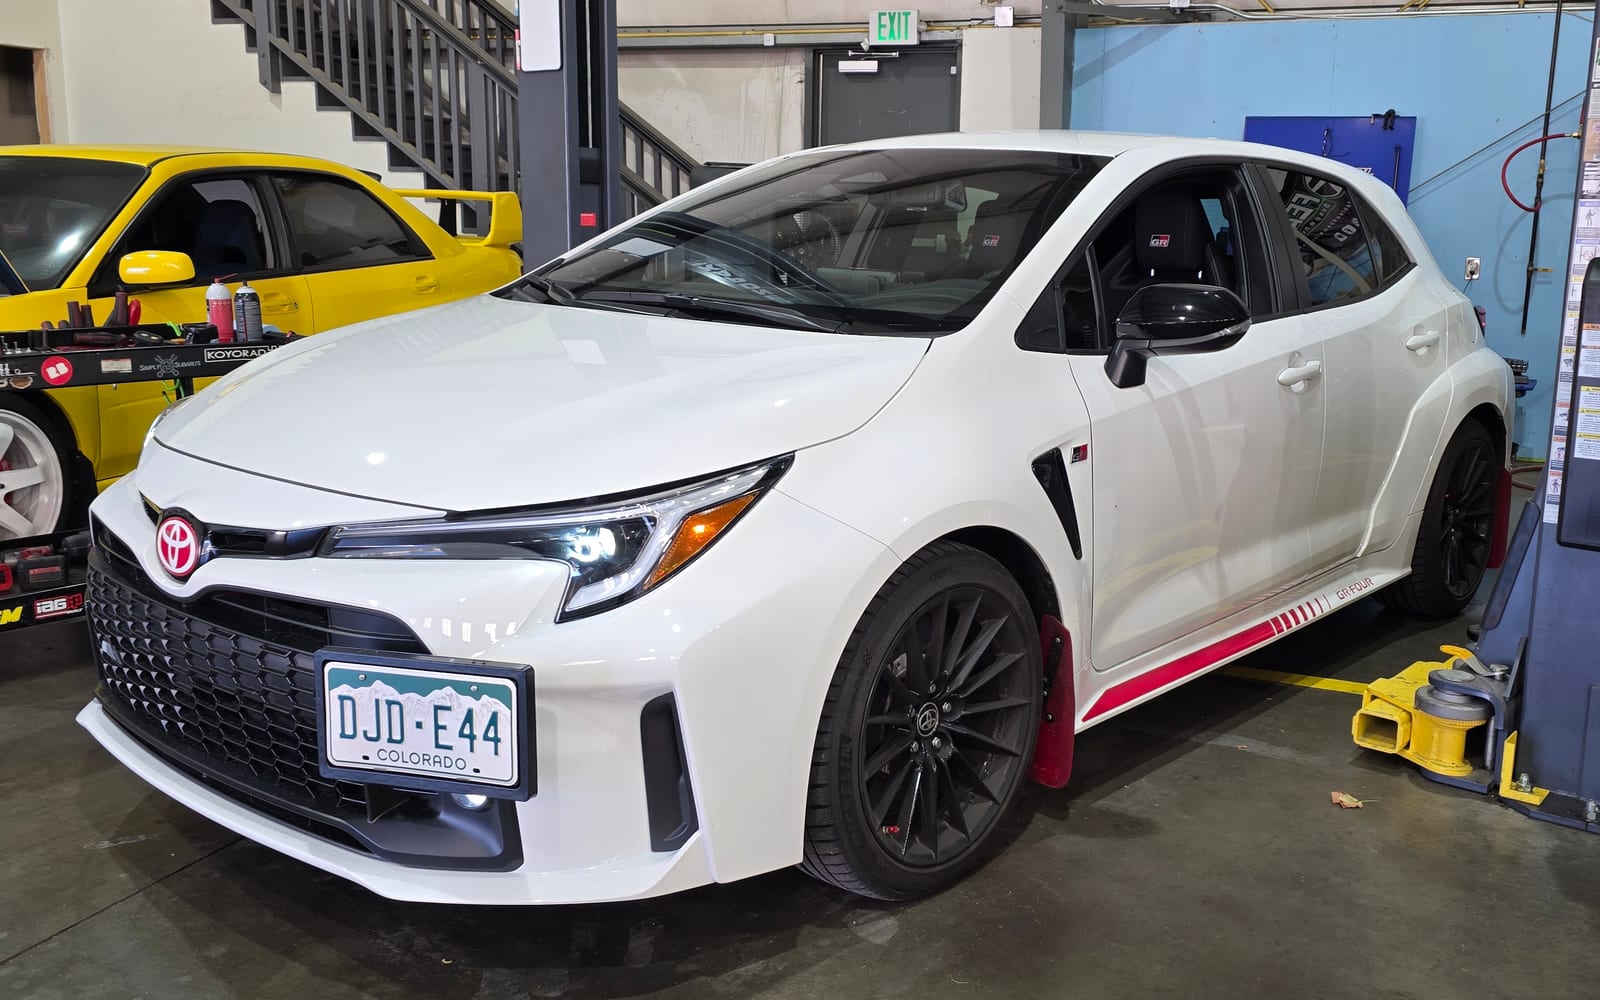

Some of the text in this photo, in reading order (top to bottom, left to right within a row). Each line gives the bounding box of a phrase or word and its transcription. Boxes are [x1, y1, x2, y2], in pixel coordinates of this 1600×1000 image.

[877, 11, 911, 41] EXIT
[983, 238, 999, 246] GR
[1150, 238, 1169, 247] GR
[207, 348, 267, 360] KOYORAD
[376, 748, 467, 770] COLORADO
